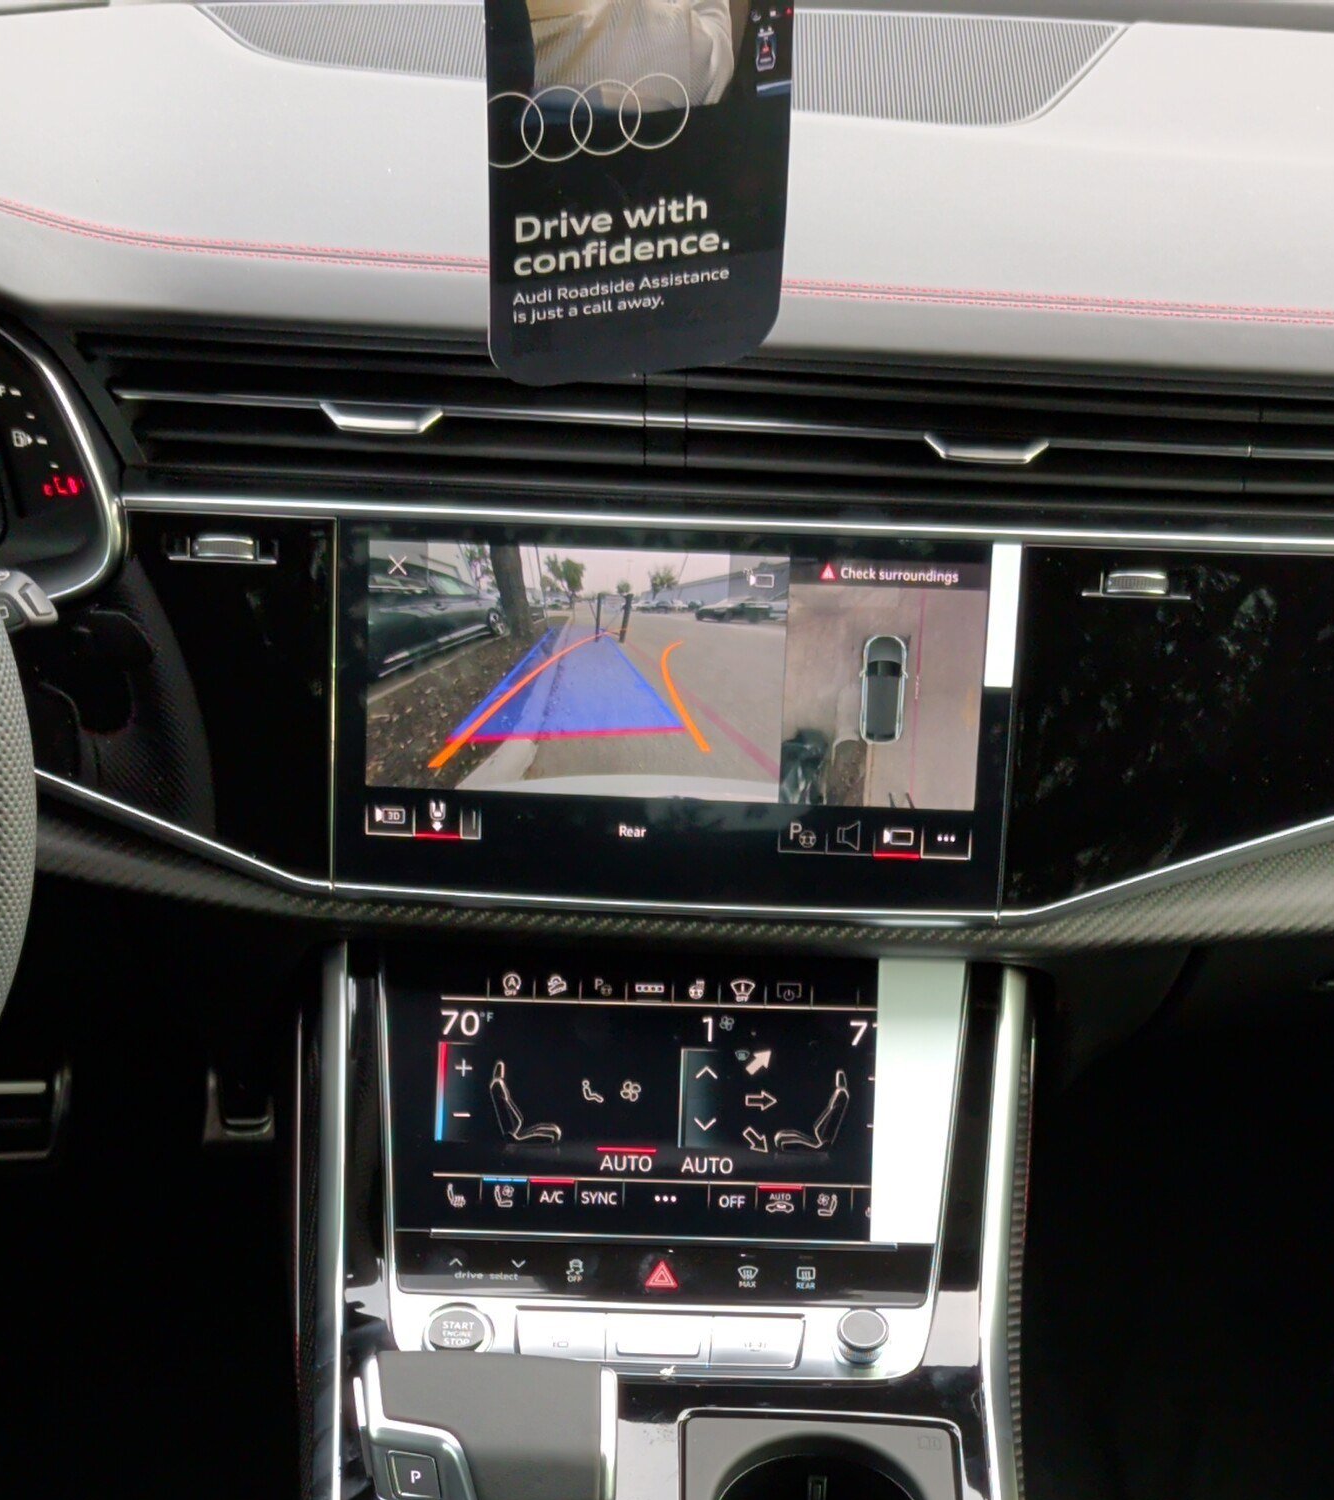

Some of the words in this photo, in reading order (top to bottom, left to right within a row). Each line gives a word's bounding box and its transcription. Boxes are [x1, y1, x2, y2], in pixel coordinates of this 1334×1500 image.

[514, 209, 613, 244] Drive
[623, 193, 709, 230] with
[513, 229, 731, 277] confidence.
[512, 290, 552, 307] Audi
[556, 279, 635, 301] Roadside
[638, 267, 731, 291] Assistance
[513, 310, 527, 324] is
[530, 305, 564, 326] just
[568, 306, 578, 319] a
[582, 300, 613, 316] call
[617, 294, 666, 313] away.
[840, 566, 876, 580] Check
[879, 569, 959, 586] surroundings
[386, 811, 401, 821] 3D
[618, 823, 647, 838] Rear
[702, 1016, 714, 1042] 1
[600, 1155, 652, 1172] AUTO
[681, 1157, 734, 1175] AUTO
[539, 1190, 564, 1205] A/C
[581, 1191, 617, 1206] SYNC
[719, 1195, 746, 1209] OFF
[769, 1193, 791, 1201] AUTO
[454, 1270, 484, 1280] drive
[489, 1272, 519, 1281] select
[567, 1275, 583, 1283] OFF
[738, 1280, 757, 1288] MAX
[795, 1281, 816, 1290] REAR
[442, 1320, 474, 1330] START
[443, 1337, 470, 1346] STOP
[410, 1470, 423, 1484] P
